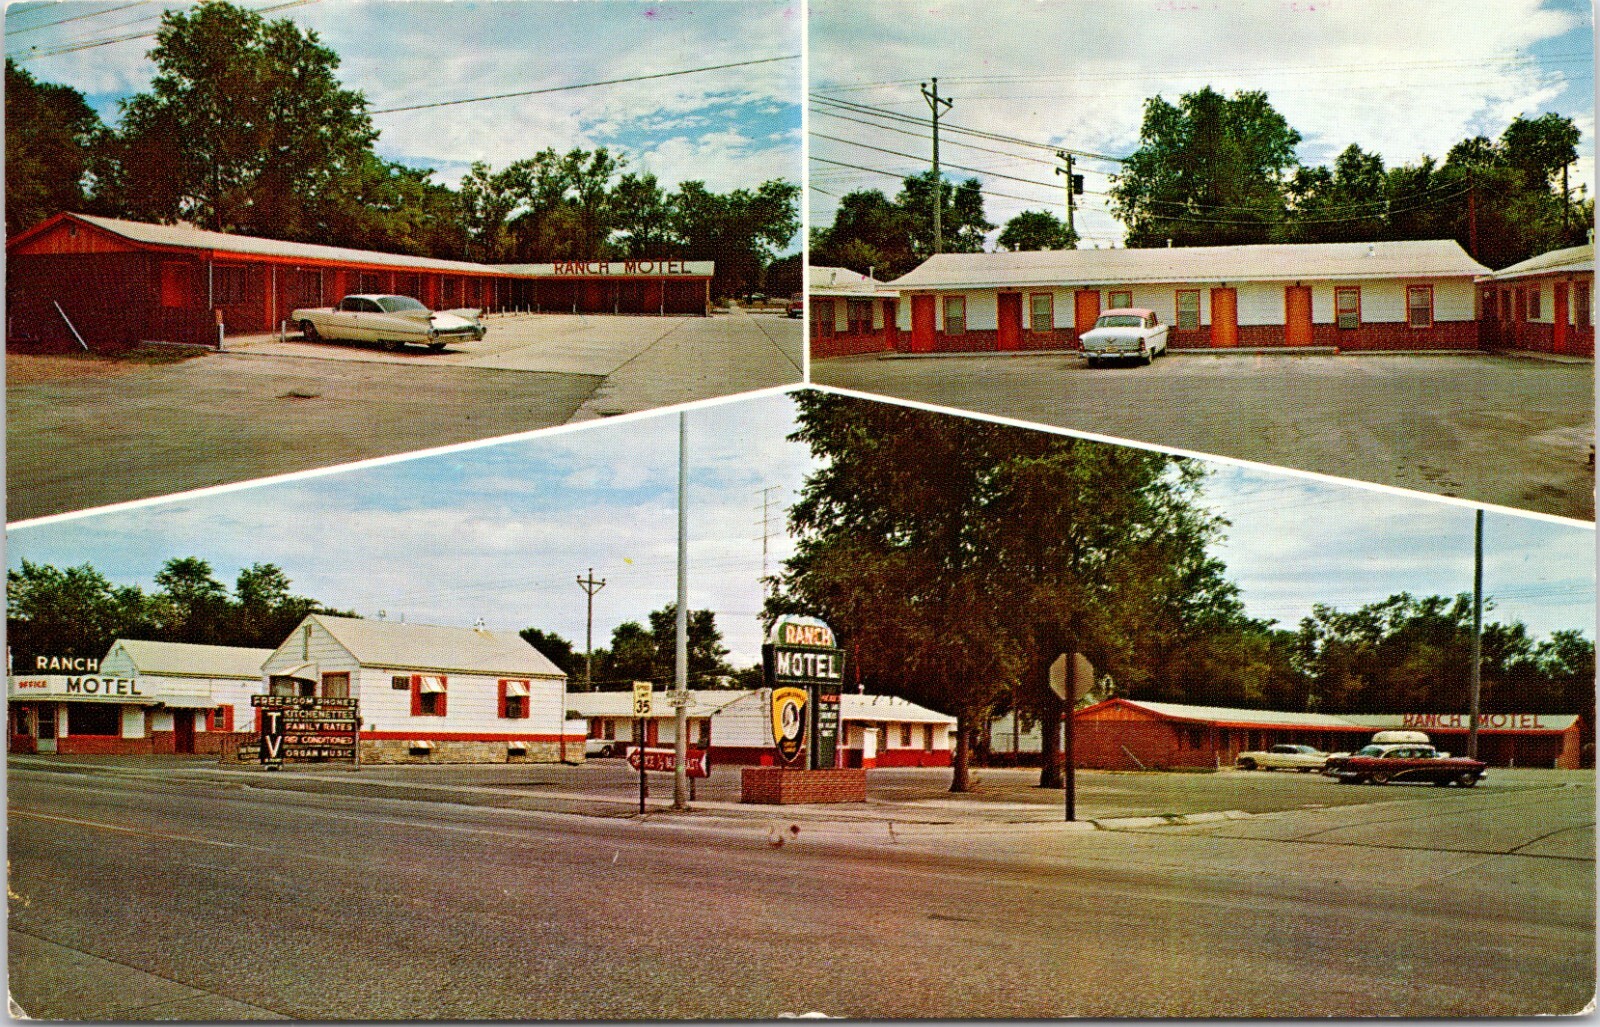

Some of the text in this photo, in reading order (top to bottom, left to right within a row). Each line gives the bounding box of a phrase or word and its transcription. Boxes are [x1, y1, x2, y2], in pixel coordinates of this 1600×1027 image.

[554, 259, 692, 275] RANCH MOTEL
[785, 624, 833, 646] RANCH
[35, 656, 99, 671] RANCH
[777, 651, 841, 679] MOTEL
[18, 680, 48, 689] OFFICE
[66, 677, 142, 695] MOTEL
[253, 696, 356, 706] FREE ROOM PHONES
[636, 699, 650, 714] 35
[284, 710, 354, 719] KITCHENETTES
[1402, 713, 1545, 729] RANCH MOTEL
[285, 722, 353, 731] FAMILY RATES
[284, 735, 354, 744] AIR CONDITIONED
[285, 749, 352, 757] ORGAN MUSIC
